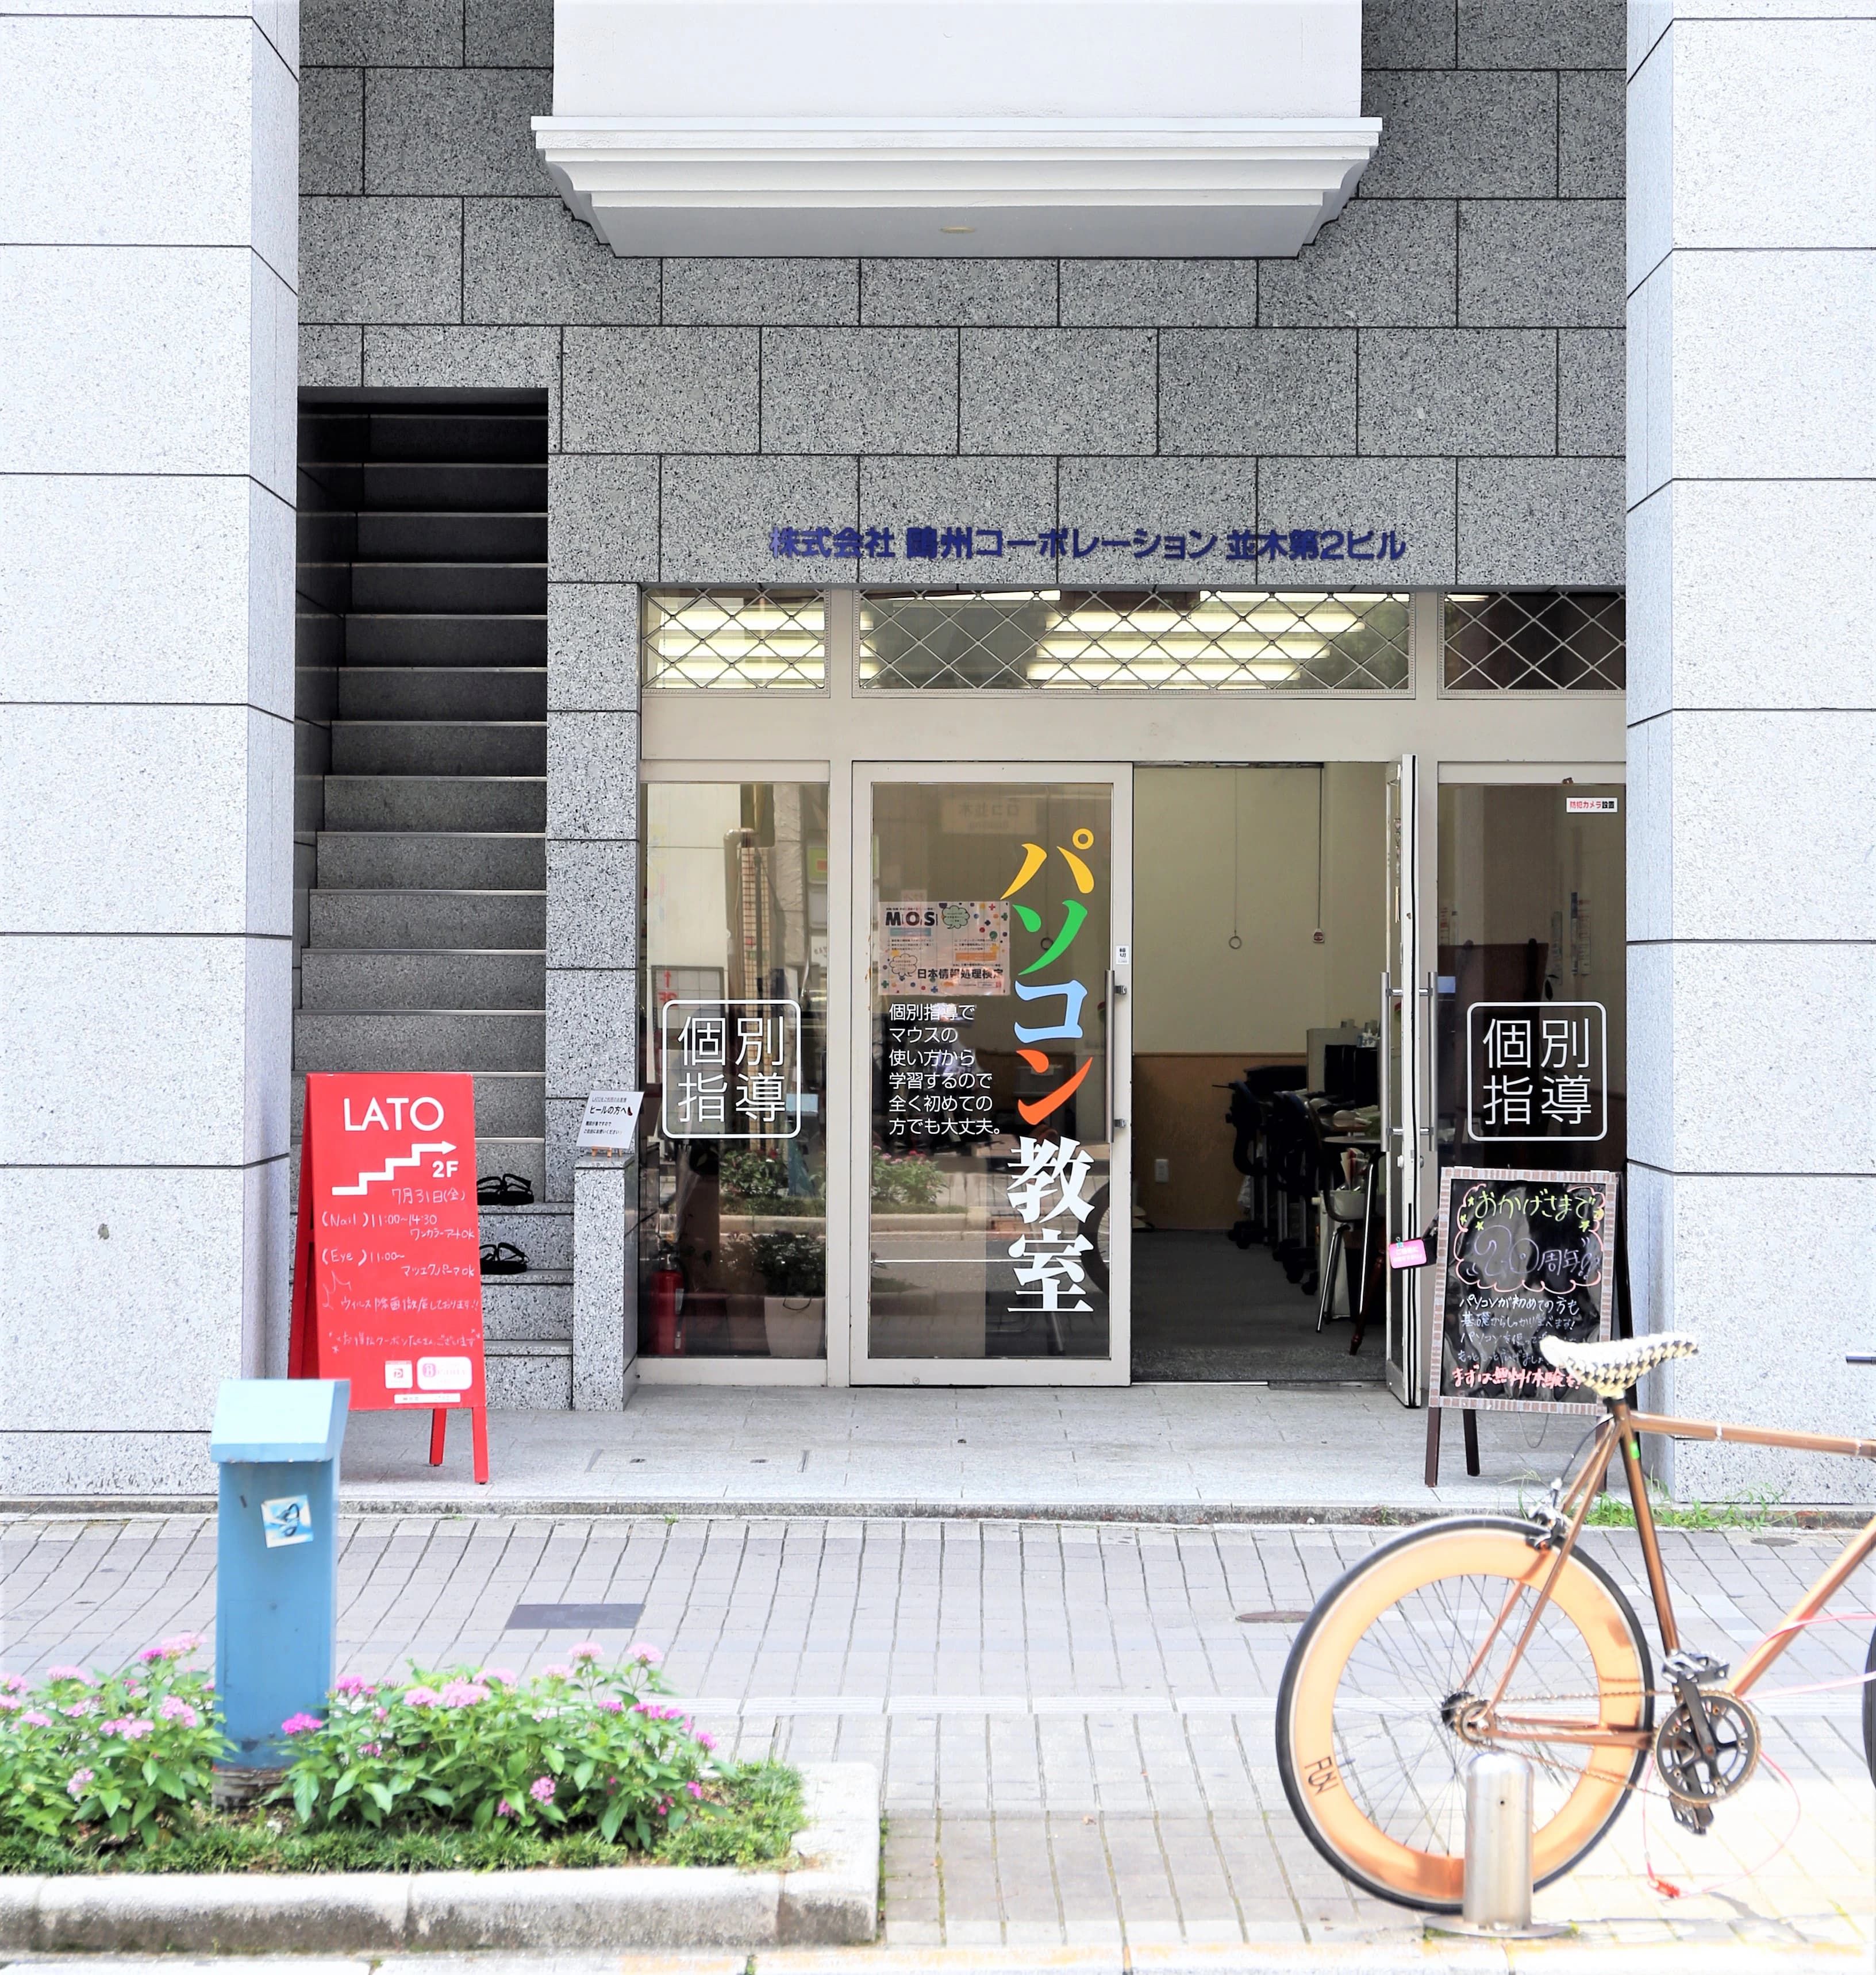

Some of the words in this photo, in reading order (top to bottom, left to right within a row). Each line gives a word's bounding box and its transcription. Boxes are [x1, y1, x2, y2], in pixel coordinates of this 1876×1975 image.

[769, 526, 896, 559] 株式会社
[1226, 529, 1407, 560] 並木第2ビル
[1570, 800, 1614, 809] 防犯カメラ設置
[885, 911, 936, 926] MOS
[889, 1003, 975, 1021] 個別指導で
[677, 1015, 785, 1067] 個別
[889, 1027, 958, 1043] マウスの
[1482, 1018, 1590, 1069] 個別
[889, 1049, 975, 1067] 使い方から
[889, 1072, 992, 1090] 学習するので
[677, 1071, 786, 1123] 指導
[889, 1095, 993, 1112] 全く初めての
[1483, 1074, 1591, 1125] 指導
[344, 1096, 445, 1131] LATO
[889, 1119, 999, 1135] 方でも大丈夫。
[432, 1160, 459, 1178] 2F
[391, 1187, 466, 1205] 7月31日(金)
[1475, 1188, 1596, 1222] おかげさまで
[1459, 1293, 1579, 1315] パソコンが初めての方も
